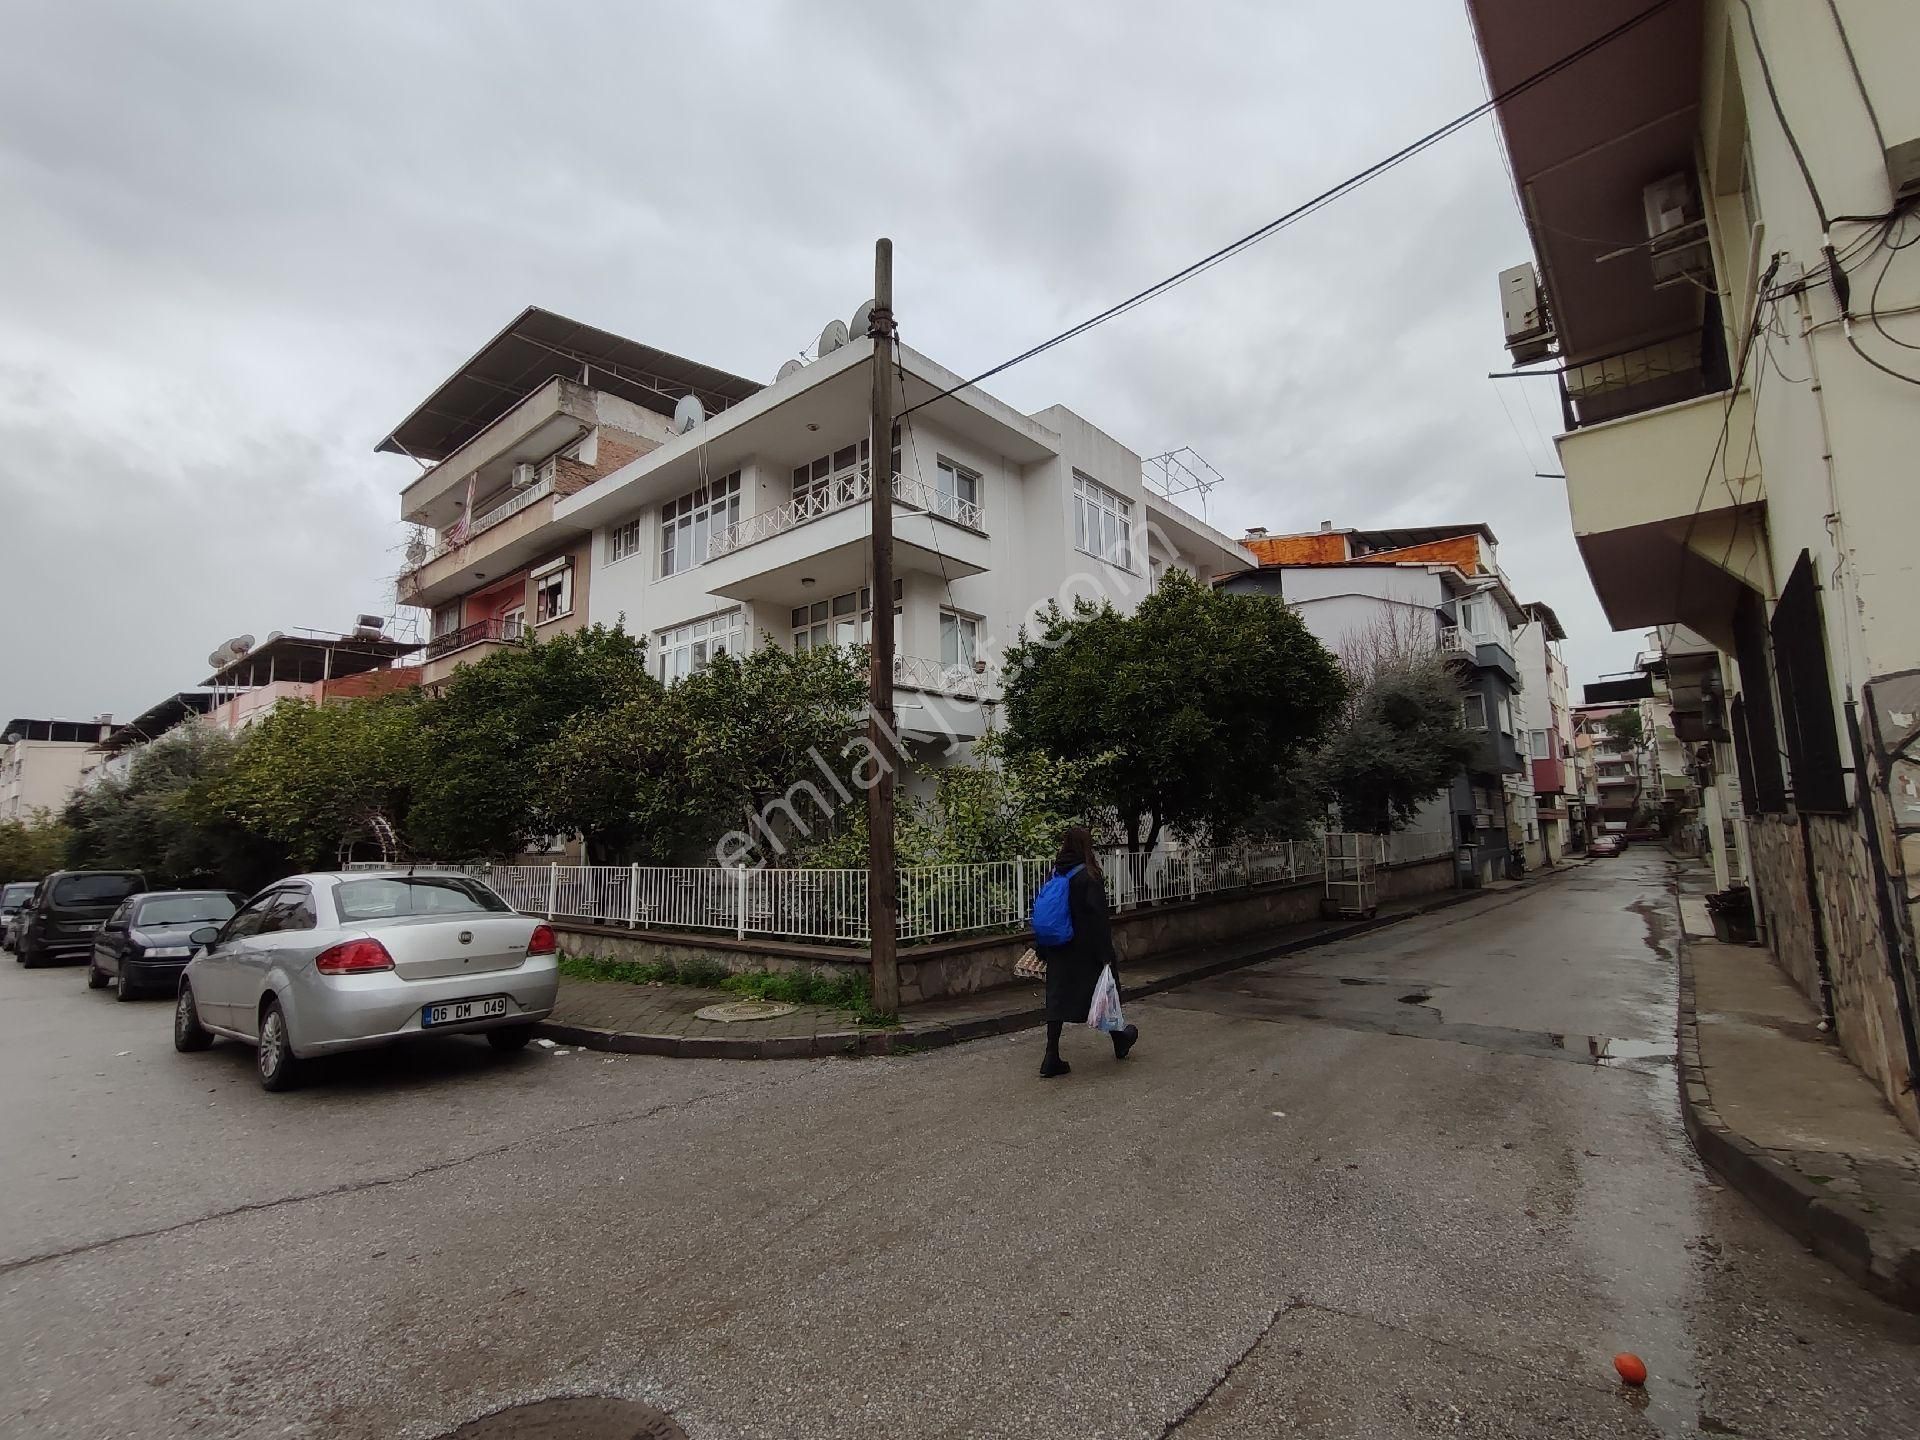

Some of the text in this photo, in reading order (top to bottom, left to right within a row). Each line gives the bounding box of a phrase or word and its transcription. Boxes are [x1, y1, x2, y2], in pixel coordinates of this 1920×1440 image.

[433, 999, 505, 1021] 06 DM 049
